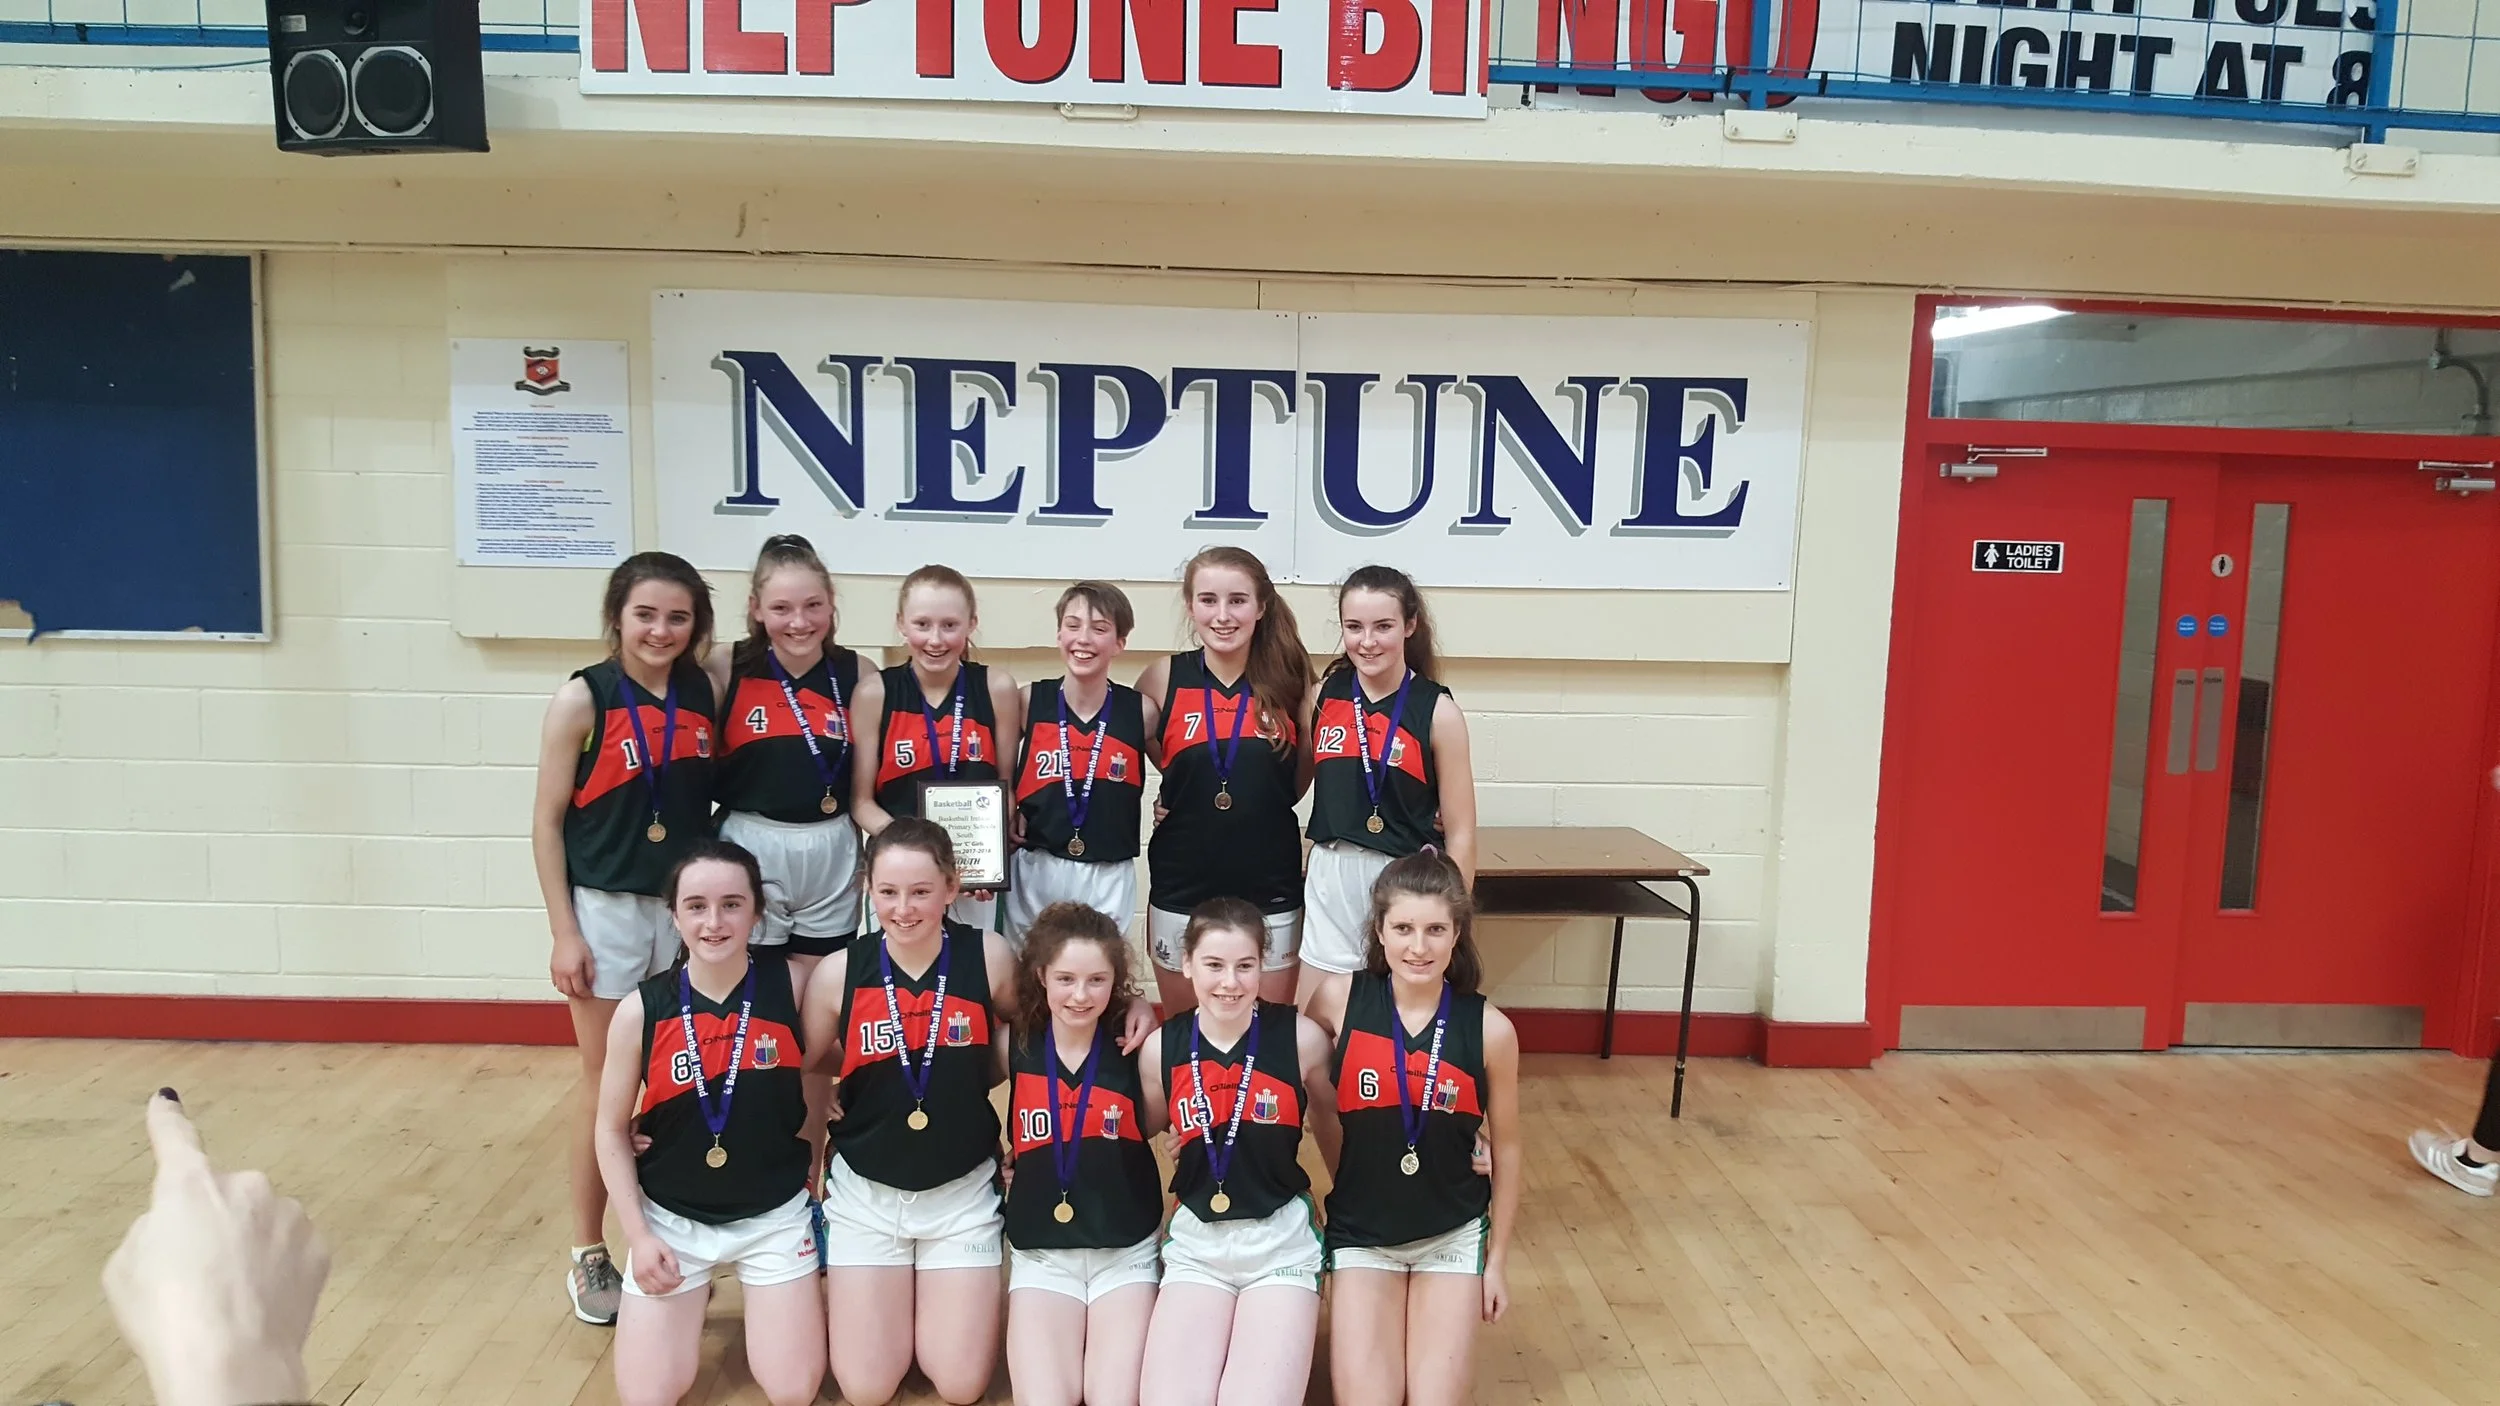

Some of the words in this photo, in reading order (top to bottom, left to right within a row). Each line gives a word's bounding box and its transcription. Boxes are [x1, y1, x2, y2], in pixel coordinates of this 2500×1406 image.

[1890, 22, 2173, 97] NIGHT
[2194, 40, 2304, 101] AT
[712, 349, 1752, 537] NEPTUNE
[2006, 544, 2053, 557] LADIES
[2006, 556, 2052, 569] TOILET
[746, 706, 768, 733] 4
[783, 687, 808, 726] Basketball
[802, 726, 821, 755] Ireland
[952, 702, 963, 742] Basketball
[1185, 712, 1202, 740] 7
[1354, 703, 1367, 744] Basketball
[895, 740, 915, 768] 5
[1060, 727, 1071, 767] Basketball
[1084, 749, 1101, 791] Basketball
[1094, 721, 1107, 749] Ireland
[1317, 726, 1346, 753] 12
[949, 744, 960, 773] Ireland
[1036, 750, 1064, 779] 21
[1360, 745, 1372, 773] Ireland
[1063, 769, 1075, 798] Ireland
[885, 983, 903, 1031] Basketball
[895, 1032, 910, 1066] Ireland
[923, 1010, 941, 1059] Basketball
[933, 976, 947, 1009] Ireland
[682, 1013, 700, 1063] Basketball
[693, 1064, 709, 1097] Ireland
[726, 1036, 744, 1086] Basketball
[737, 1000, 752, 1035] Ireland
[860, 1020, 895, 1056] 15
[1427, 1027, 1444, 1076] Basketball
[671, 1050, 694, 1085] 8
[1358, 1068, 1379, 1100] 6
[1191, 1060, 1206, 1110] Basketball
[1200, 1111, 1213, 1144] Ireland
[1227, 1089, 1247, 1137] Basketball
[1240, 1055, 1255, 1089] Ireland
[1421, 1078, 1435, 1111] Ireland
[1020, 1109, 1051, 1142] 10
[1178, 1095, 1214, 1132] 13
